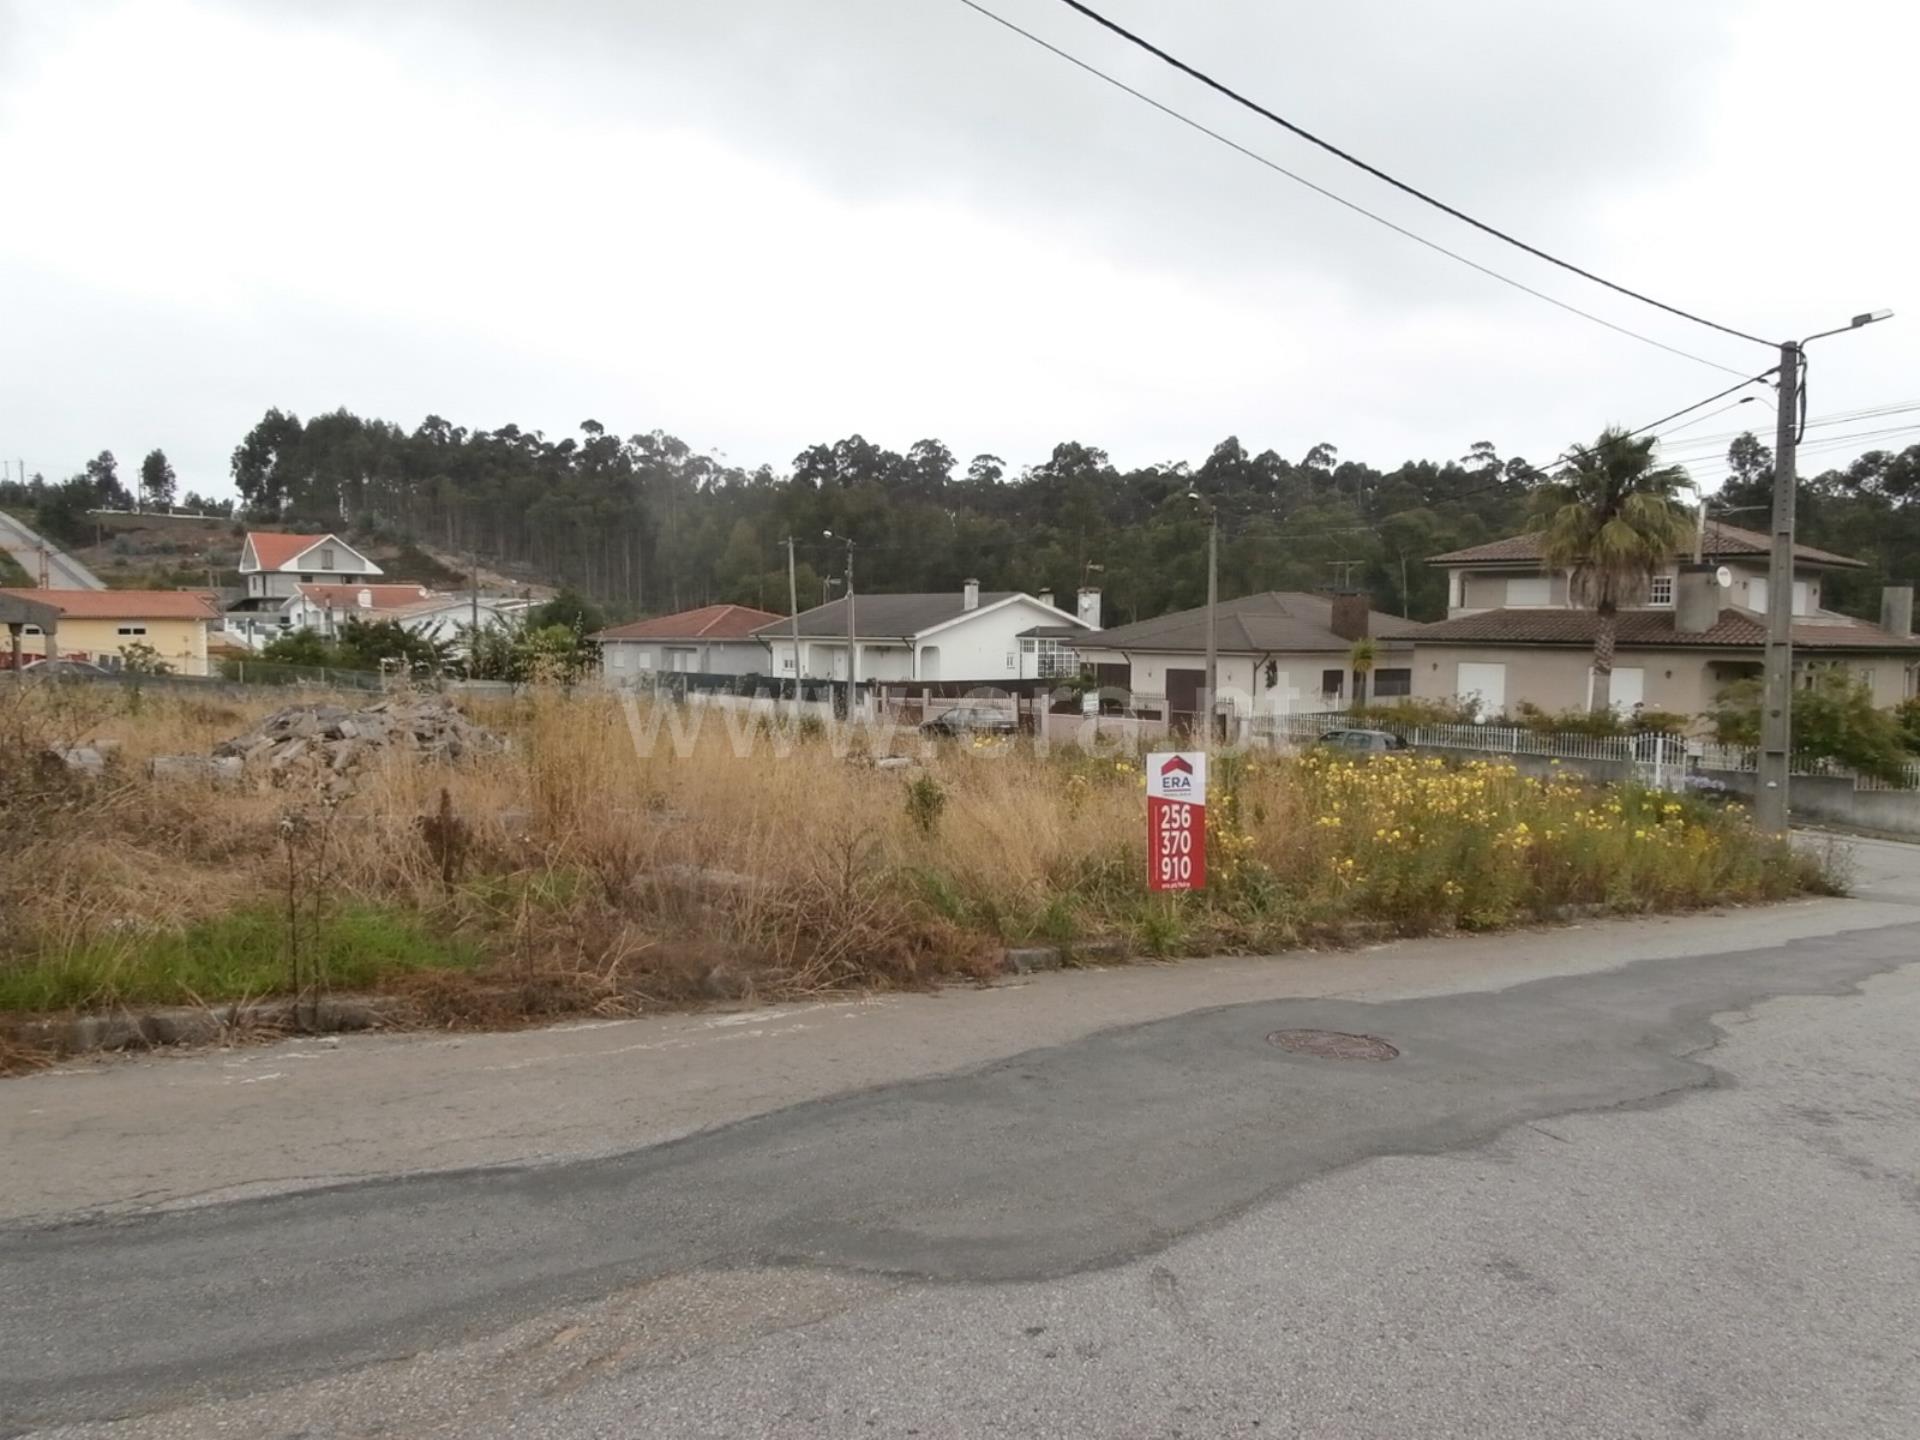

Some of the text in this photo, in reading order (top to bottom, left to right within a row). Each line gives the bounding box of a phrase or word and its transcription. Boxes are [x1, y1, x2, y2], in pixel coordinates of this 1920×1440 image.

[1162, 776, 1191, 788] ERA
[1161, 804, 1191, 829] 256
[1161, 830, 1191, 855] 370
[1161, 856, 1191, 881] 910
